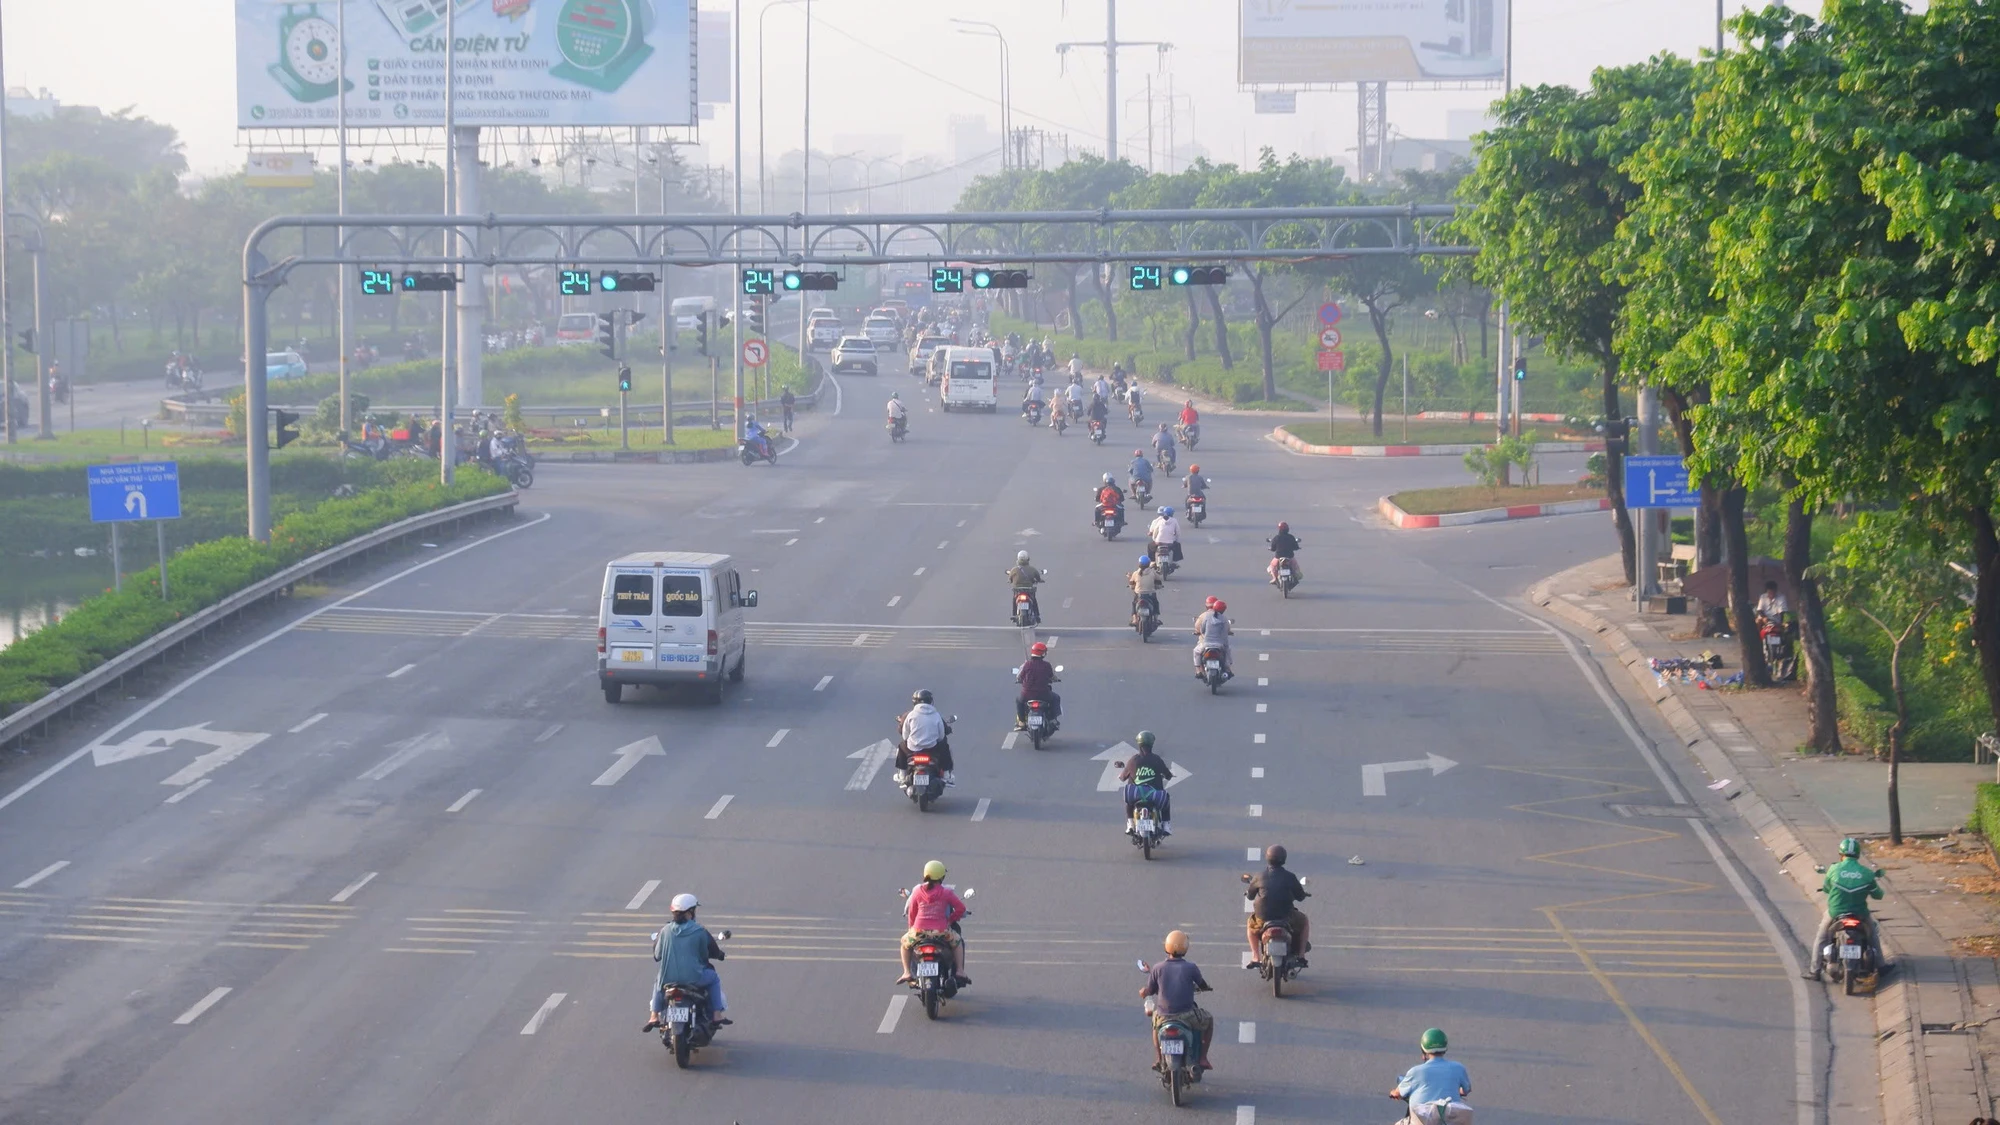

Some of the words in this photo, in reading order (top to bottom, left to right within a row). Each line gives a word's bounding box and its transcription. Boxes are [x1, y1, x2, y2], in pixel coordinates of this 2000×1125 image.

[409, 33, 447, 52] CÂN
[454, 33, 499, 56] ĐIỆN
[504, 31, 530, 53] TỬ
[364, 270, 391, 294] 24
[562, 271, 588, 293] 24
[745, 270, 772, 293] 24
[934, 269, 960, 292] 24
[1132, 267, 1159, 289] 24
[666, 590, 684, 602] QUỐC
[1840, 870, 1863, 880] Grab
